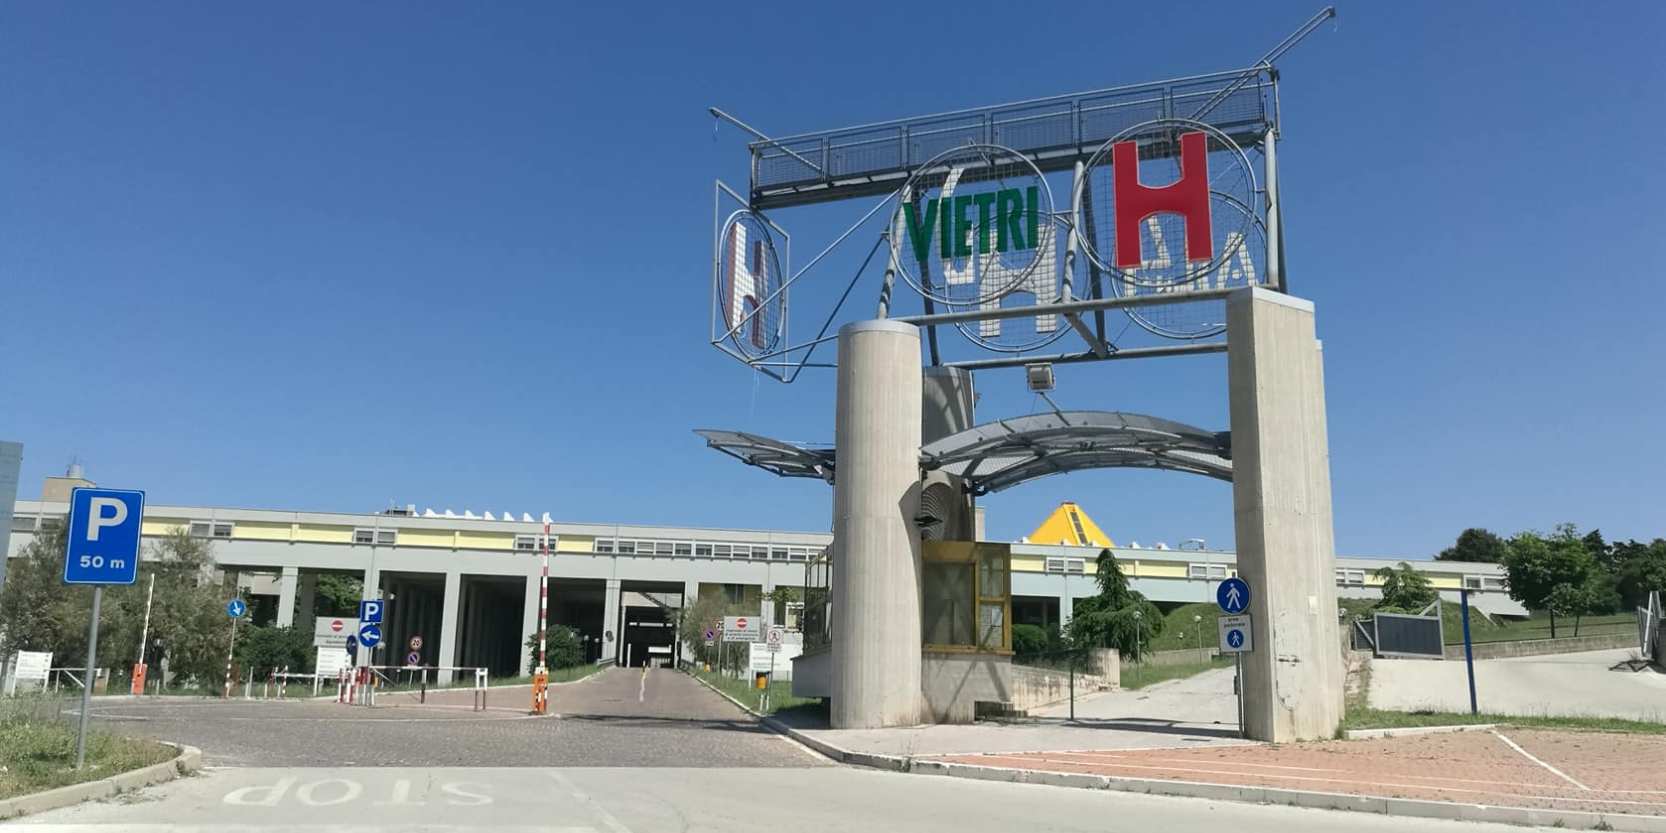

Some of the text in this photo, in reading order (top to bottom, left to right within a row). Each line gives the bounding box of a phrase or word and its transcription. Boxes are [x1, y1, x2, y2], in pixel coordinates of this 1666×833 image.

[1113, 131, 1213, 268] H
[903, 186, 1039, 263] VIETRI
[87, 497, 128, 541] P
[80, 556, 125, 569] 50 m
[364, 602, 379, 621] P
[223, 776, 494, 807] STOP
